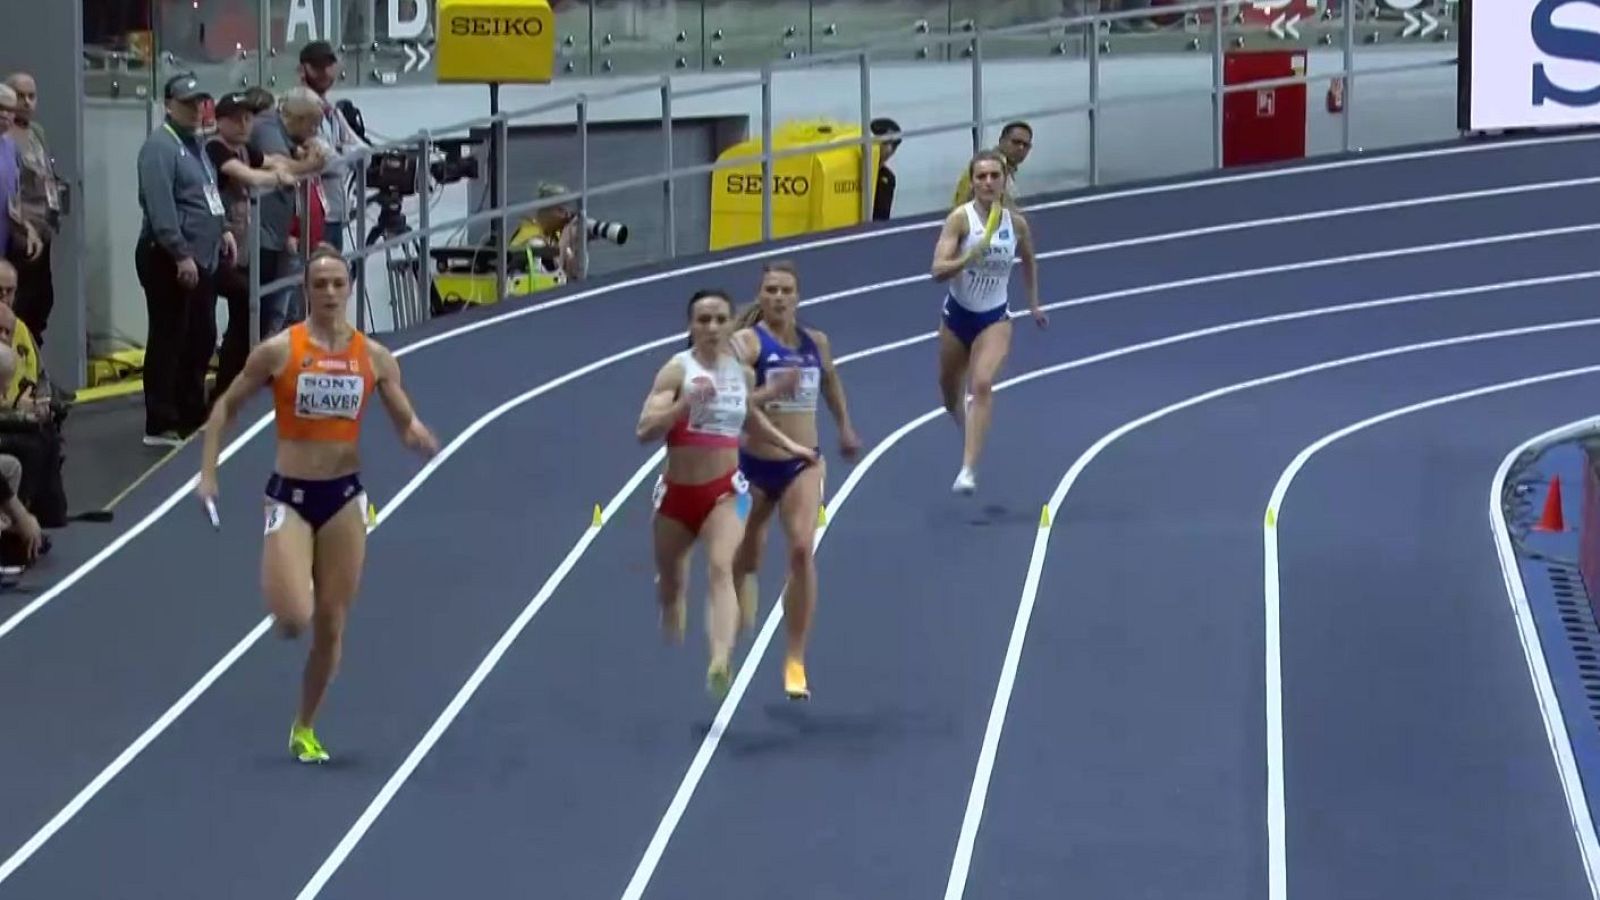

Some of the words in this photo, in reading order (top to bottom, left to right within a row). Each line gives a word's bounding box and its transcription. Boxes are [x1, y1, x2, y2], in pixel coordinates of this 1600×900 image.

[451, 16, 543, 37] SEIKO
[727, 175, 809, 196] SEKO
[300, 393, 359, 409] KLAVER
